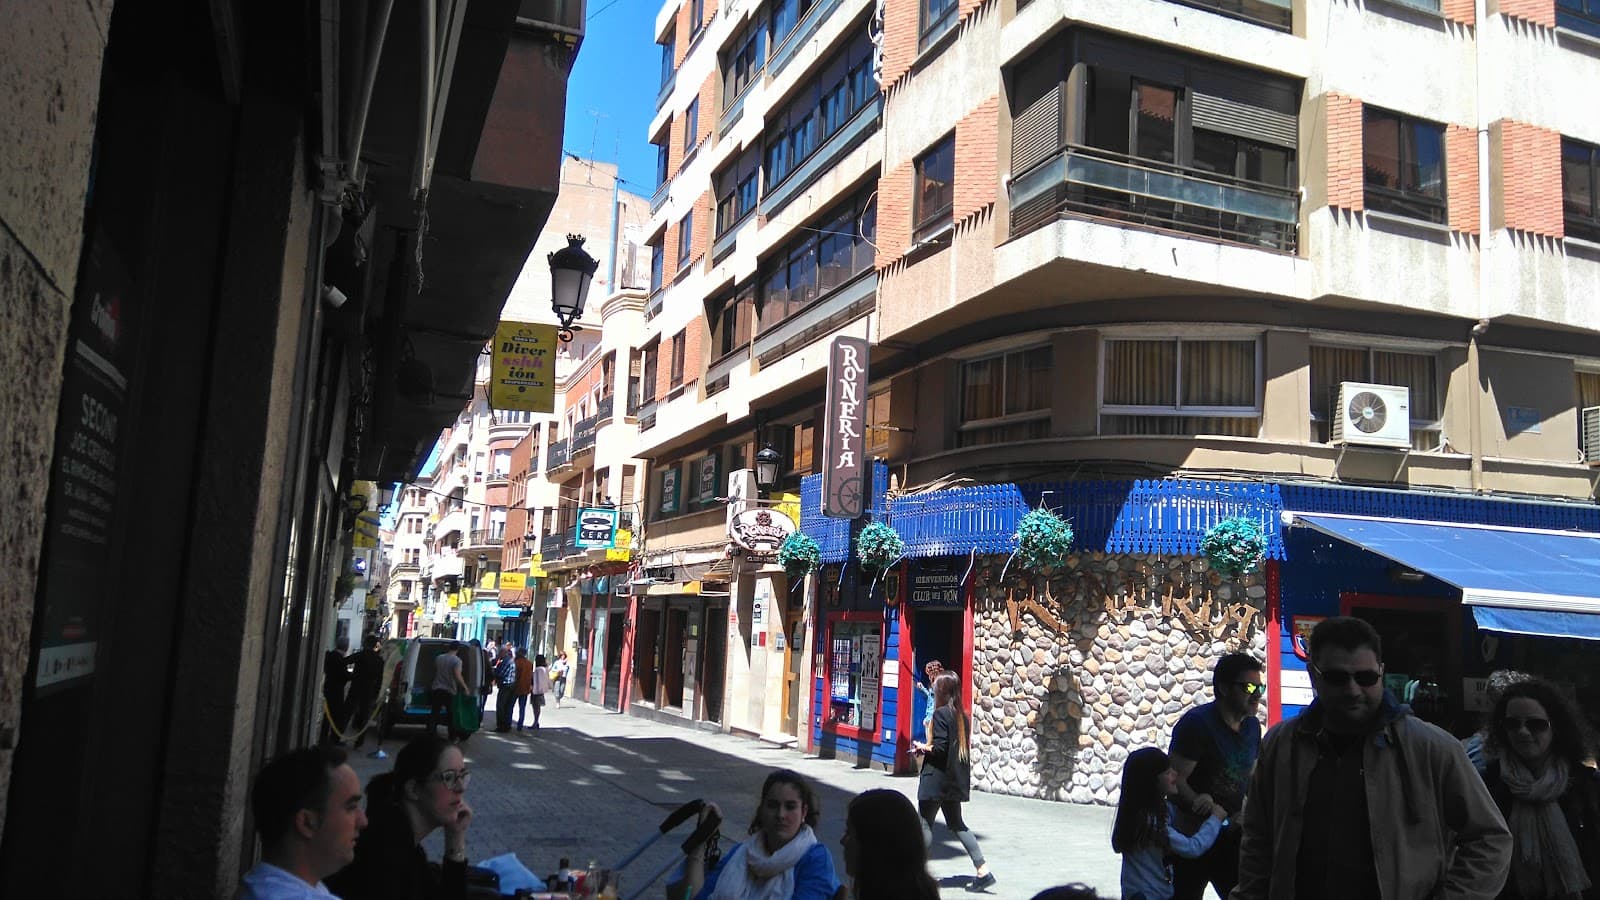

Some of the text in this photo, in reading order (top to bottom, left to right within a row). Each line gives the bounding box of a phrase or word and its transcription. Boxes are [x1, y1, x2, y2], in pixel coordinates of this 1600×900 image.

[501, 342, 547, 356] Diver
[508, 366, 536, 379] ión
[836, 343, 864, 469] RONERÍA
[915, 575, 959, 584] BIENVENIDOS
[912, 590, 930, 602] CLUB
